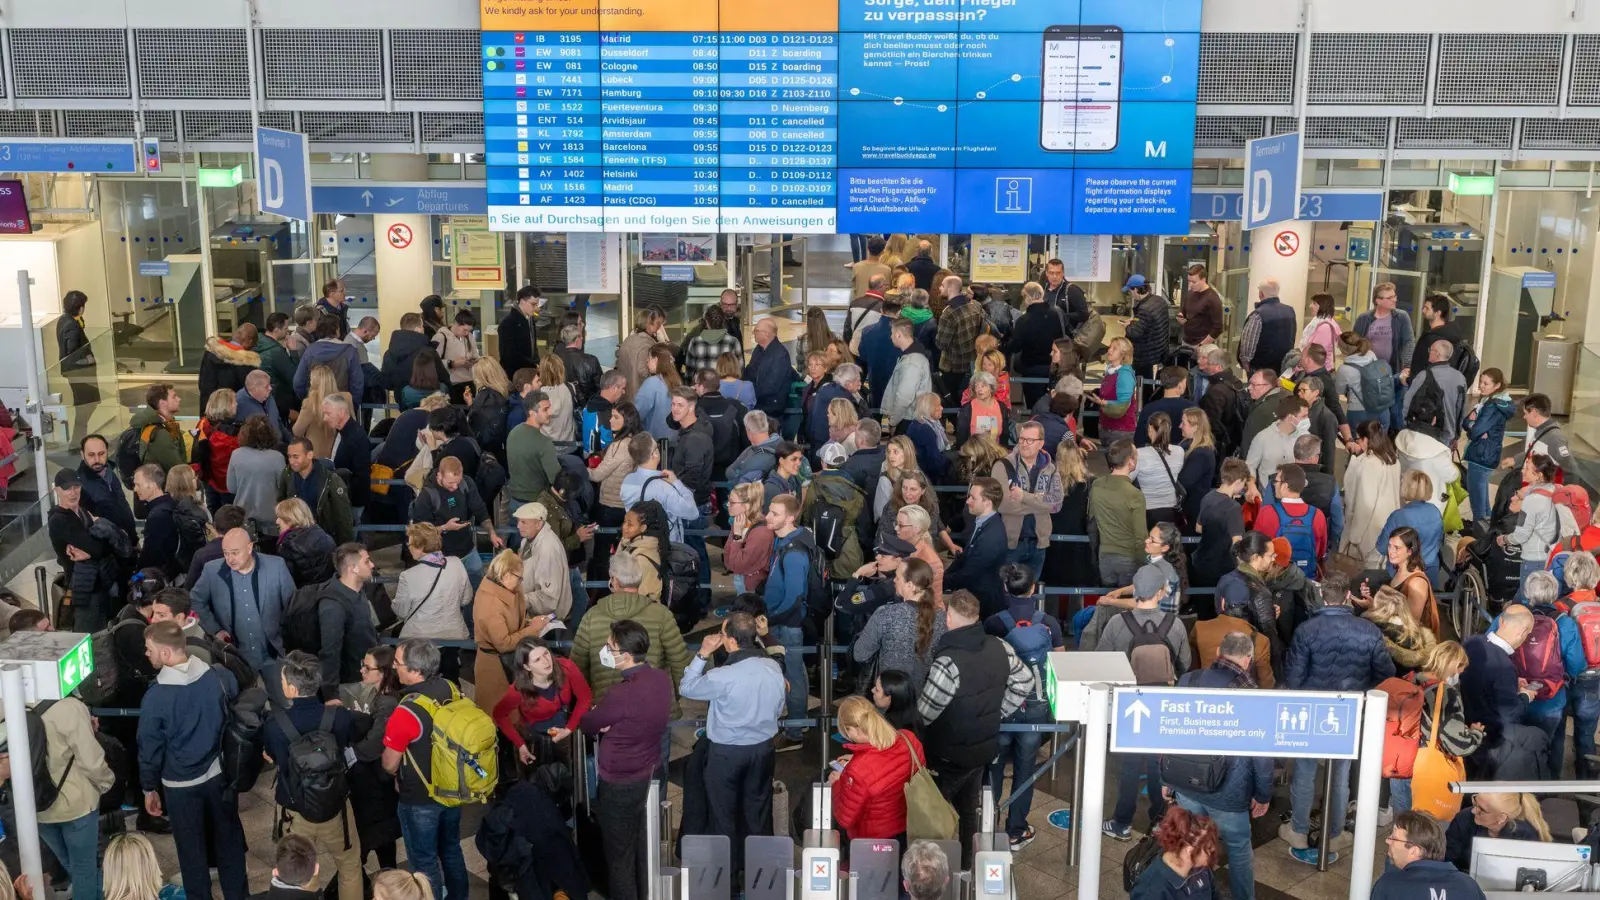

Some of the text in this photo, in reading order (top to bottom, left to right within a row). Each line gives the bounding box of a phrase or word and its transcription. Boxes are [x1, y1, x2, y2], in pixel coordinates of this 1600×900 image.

[502, 7, 526, 16] kindly
[581, 7, 645, 17] understanding.
[864, 10, 987, 23] zu verpassen?
[783, 49, 821, 58] boarding
[601, 62, 637, 71] Cologne
[783, 63, 821, 72] boarding
[602, 90, 641, 98] Hamburg
[783, 105, 829, 114] Nuernberg
[602, 117, 646, 126] Arvidsjaur
[262, 134, 285, 148] Terminal
[0, 145, 11, 160] 3
[1145, 141, 1166, 157] M
[1256, 143, 1280, 156] Terminal
[641, 156, 667, 165] (TFS)
[263, 158, 283, 208] D
[418, 189, 448, 201] Abflug
[882, 187, 925, 195] Fluganzeigen
[1252, 169, 1272, 222] D
[418, 201, 468, 212] Departures
[629, 196, 656, 205] (CDG)
[1212, 195, 1226, 216] D
[502, 214, 823, 228] Sie auf Durchsagen und folgen Sie den Anweisungen
[1161, 700, 1234, 714] Fast Track
[1160, 717, 1238, 726] First, Business and
[1160, 726, 1265, 739] Premium Passengers only
